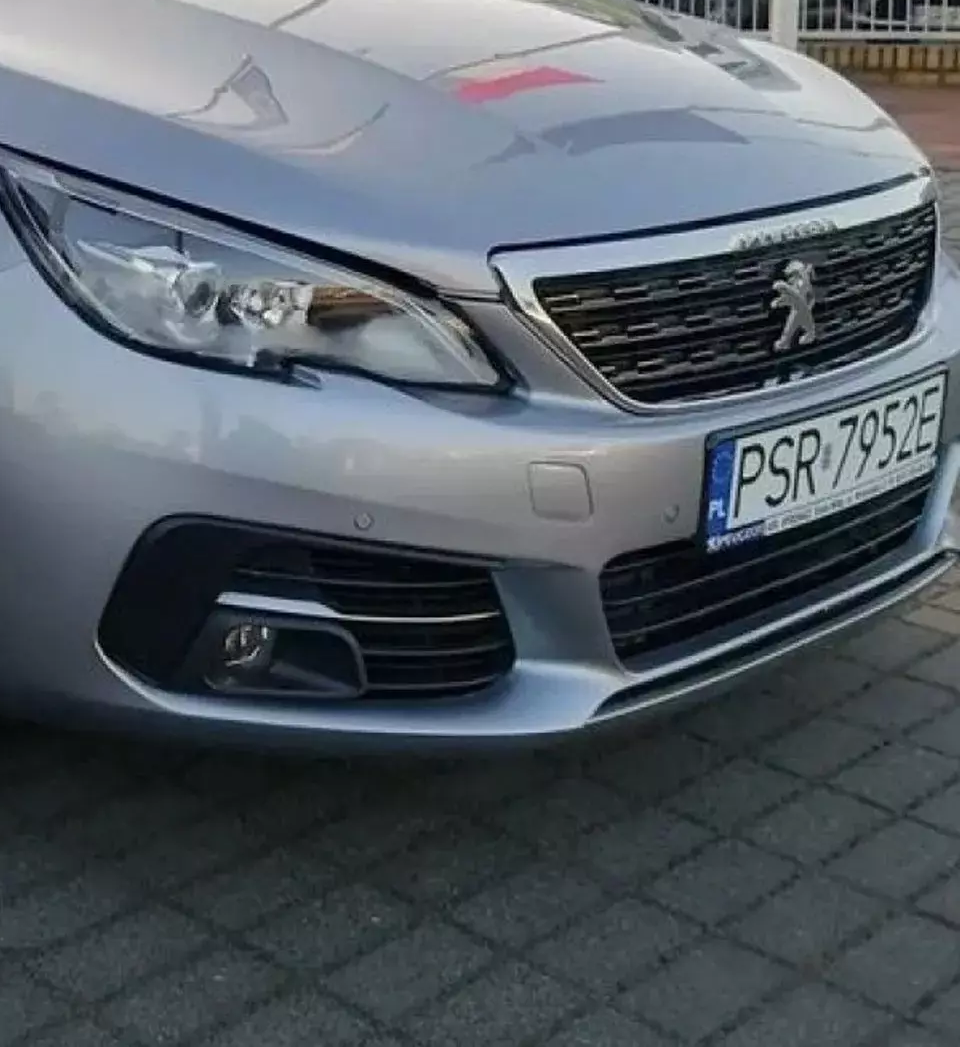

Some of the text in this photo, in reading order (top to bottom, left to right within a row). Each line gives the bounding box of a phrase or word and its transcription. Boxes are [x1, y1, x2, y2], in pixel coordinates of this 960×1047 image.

[734, 386, 940, 519] PSR 7952E
[708, 498, 726, 521] PL
